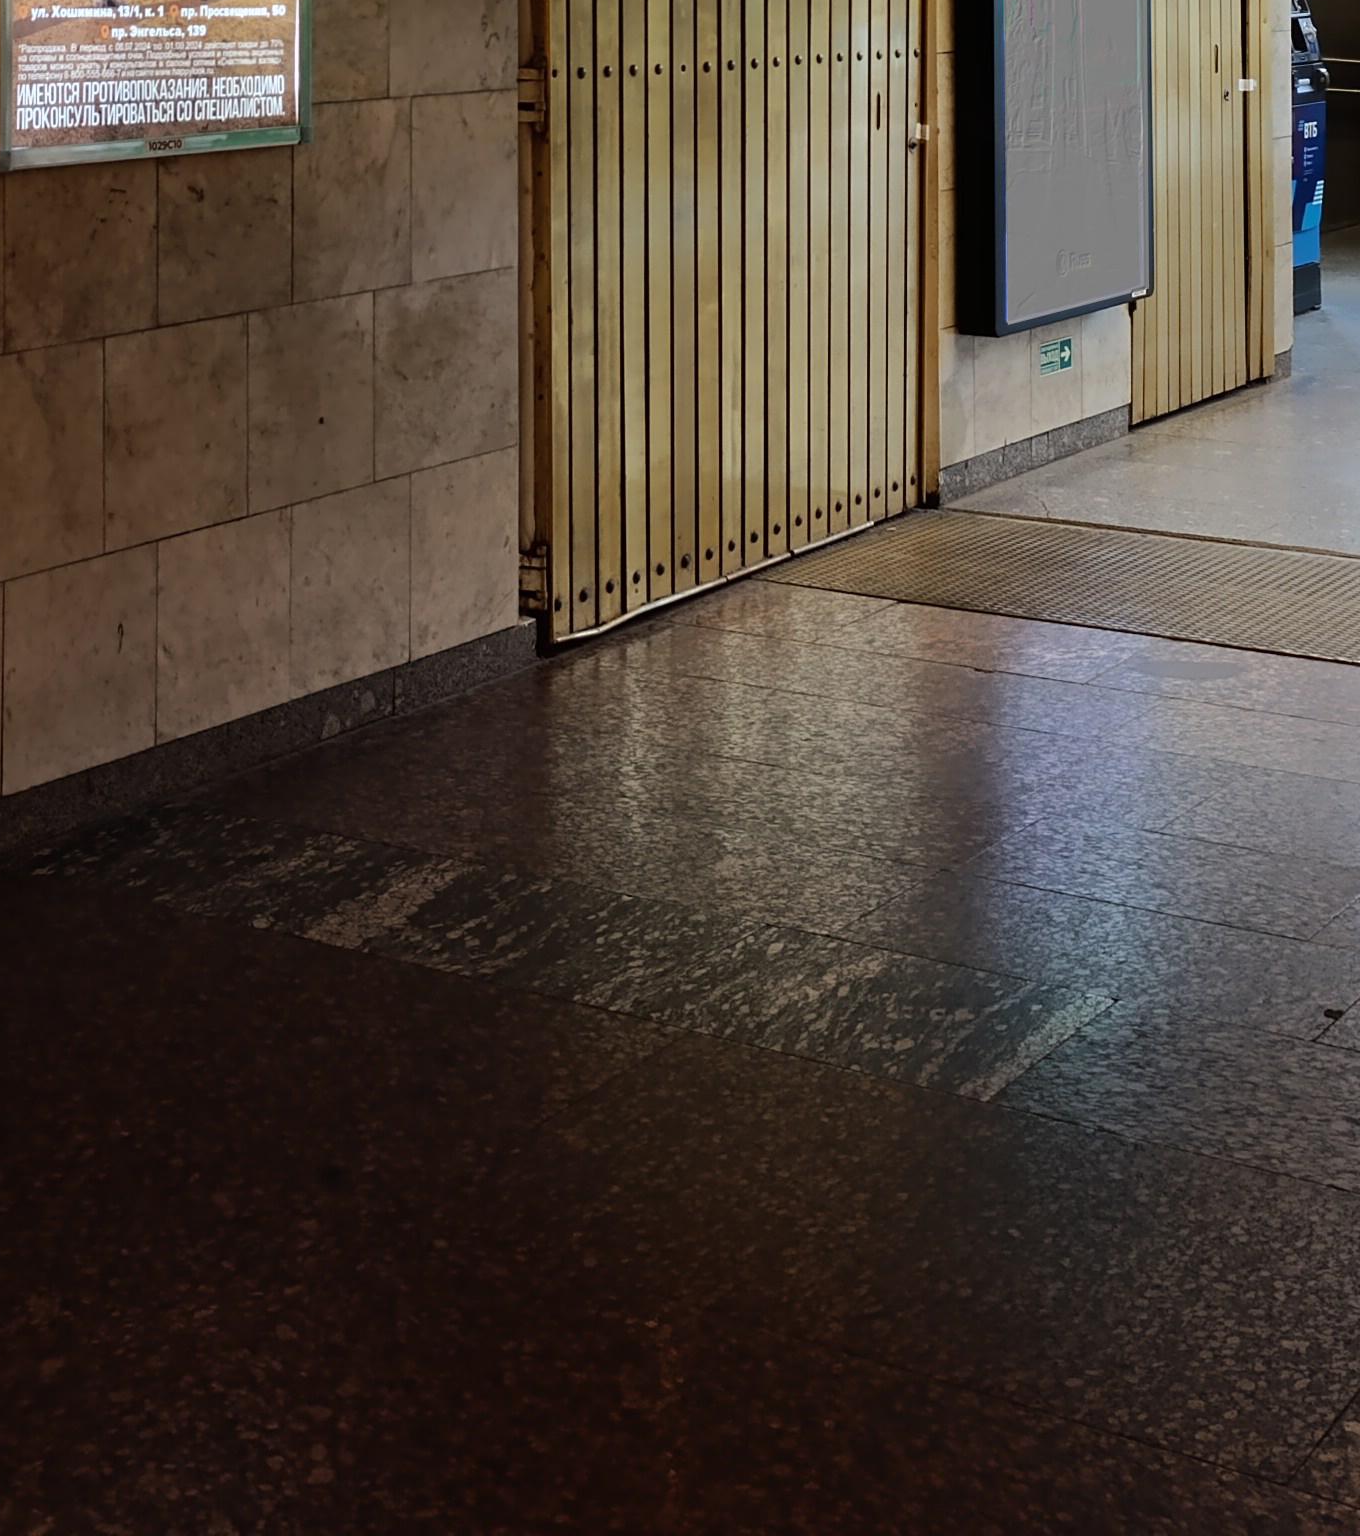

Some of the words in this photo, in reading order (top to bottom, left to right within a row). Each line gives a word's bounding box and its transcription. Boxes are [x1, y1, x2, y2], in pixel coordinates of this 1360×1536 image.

[31, 7, 49, 20] ул.
[145, 7, 156, 18] к.
[180, 7, 197, 21] пр.
[111, 28, 127, 41] пр.
[130, 25, 185, 40] Энгельса,
[188, 25, 206, 37] 139
[17, 81, 80, 106] ИМЕЮТСЯ
[83, 77, 209, 104] ПРОТИВОПОКАЗАНИЯ.
[212, 75, 285, 98] НЕОБХОДИМО
[17, 101, 174, 130] ПРОКОНСУЛЬТИРОВАТЬСЯ
[176, 101, 192, 121] СО
[194, 97, 285, 123] СПЕЦИАЛИСТОМ.
[1304, 121, 1318, 139] ВТБ
